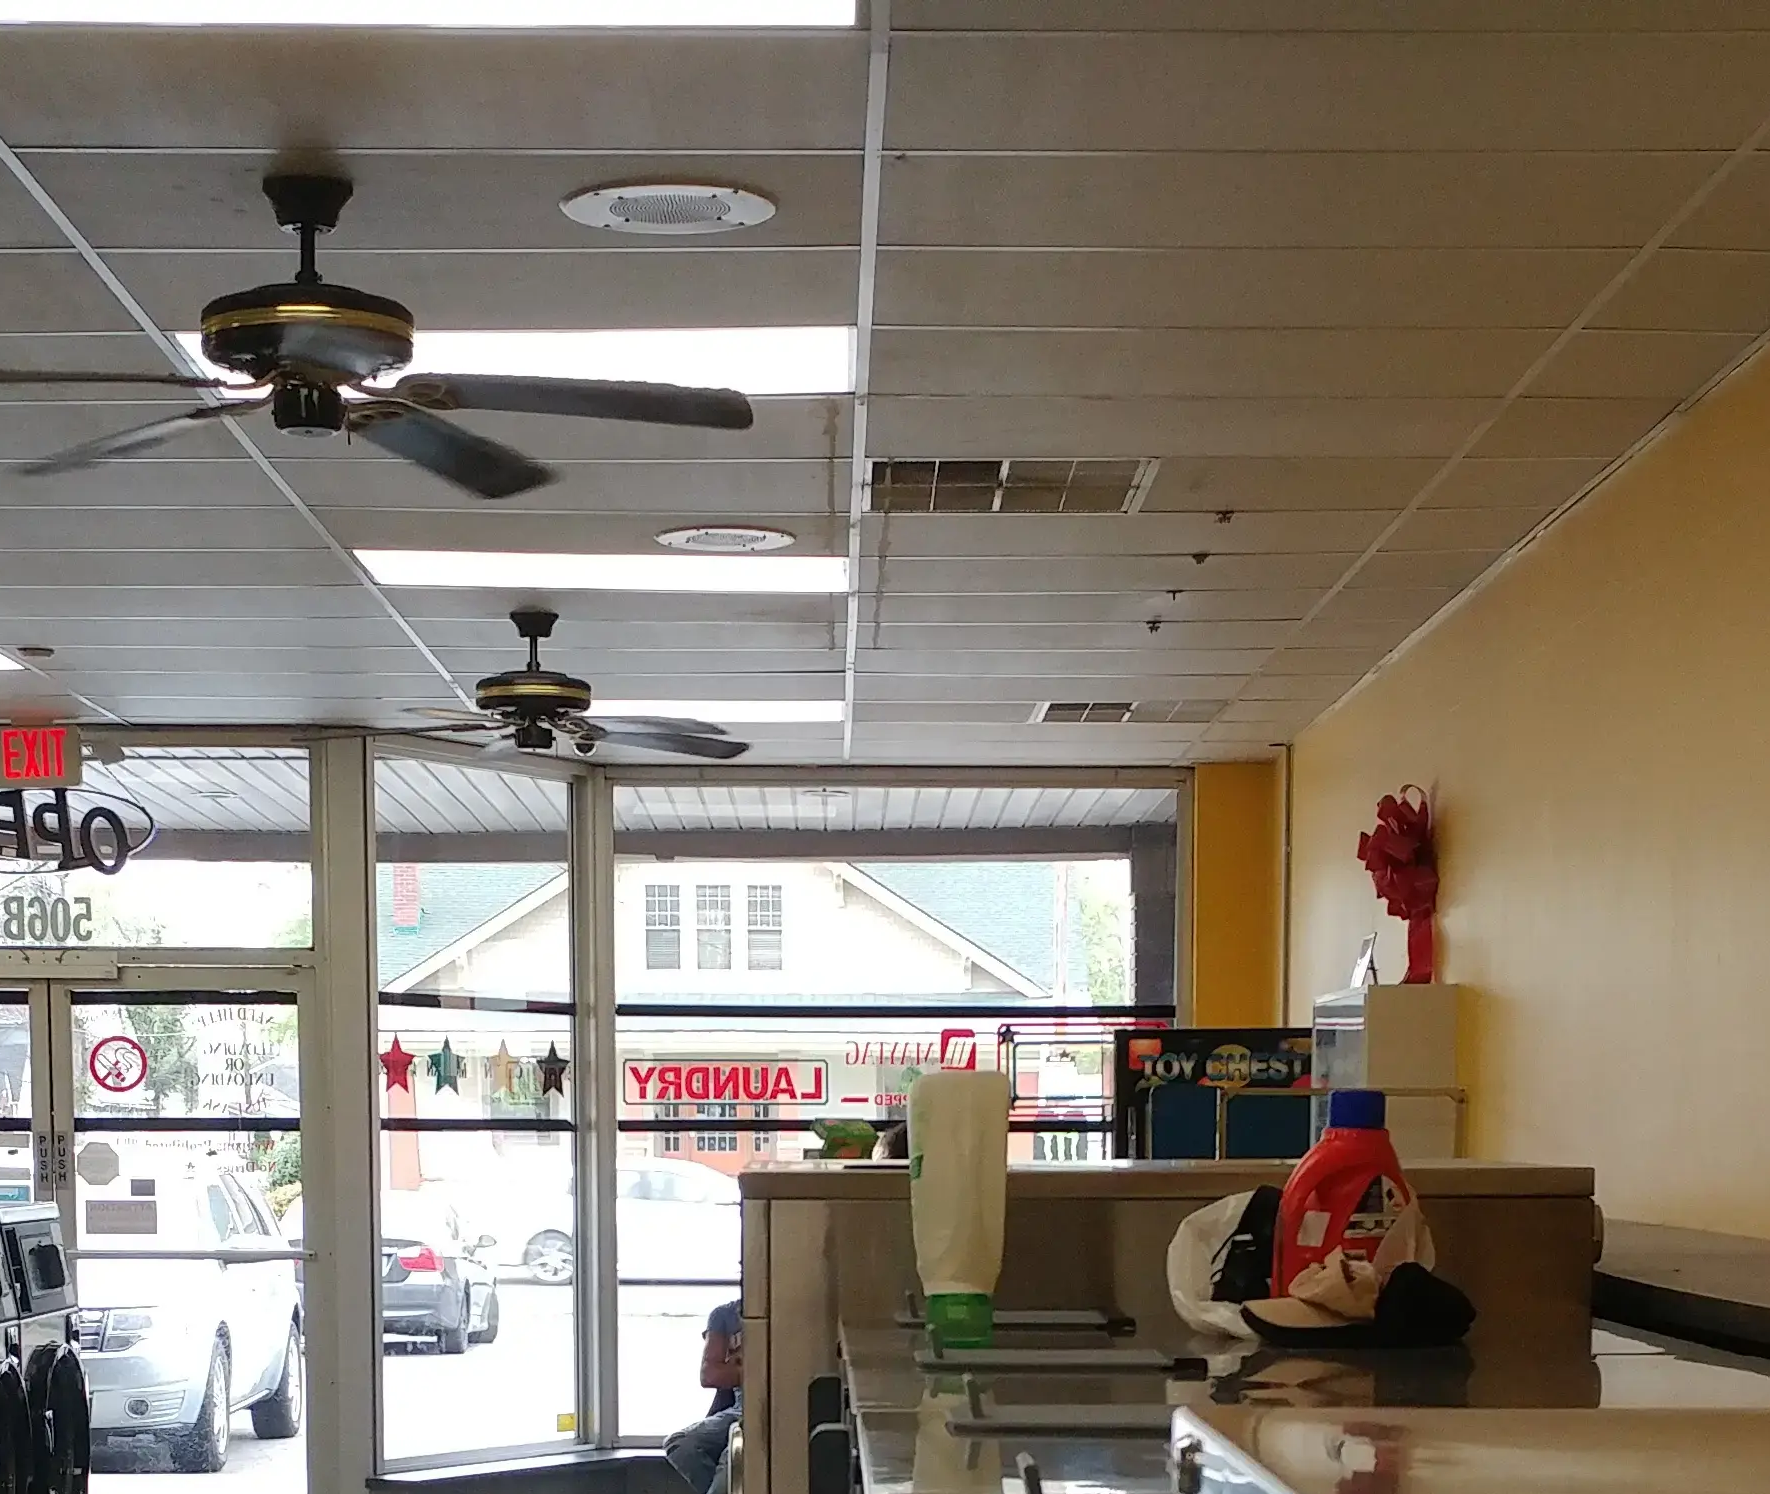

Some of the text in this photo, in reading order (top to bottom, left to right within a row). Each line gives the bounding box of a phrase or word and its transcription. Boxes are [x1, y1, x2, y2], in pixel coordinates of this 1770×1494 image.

[2, 727, 67, 780] EXIT
[1138, 1051, 1307, 1081] TOY CHEST
[39, 1135, 50, 1183] PUSH
[57, 1135, 67, 1182] PUSH
